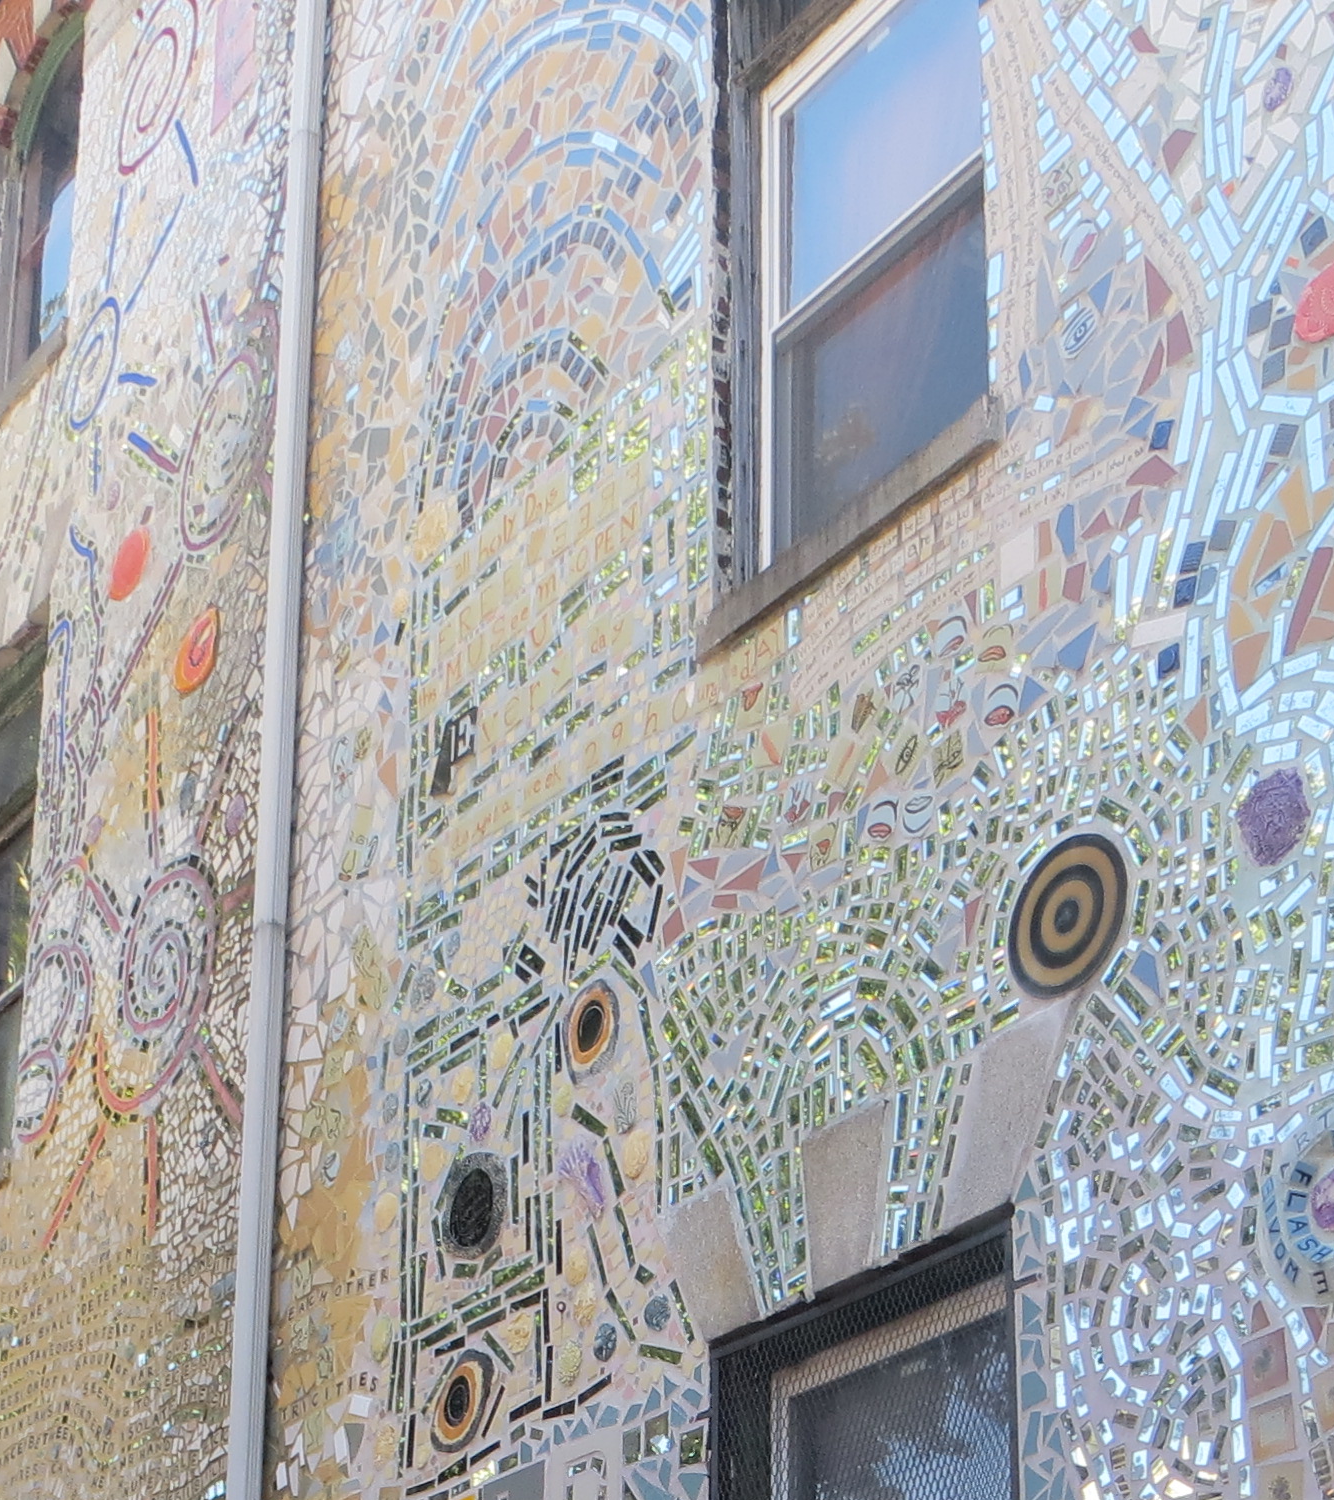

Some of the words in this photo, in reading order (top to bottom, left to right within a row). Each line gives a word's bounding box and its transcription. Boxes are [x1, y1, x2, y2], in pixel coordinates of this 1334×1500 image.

[286, 1289, 328, 1322] EACH
[334, 1268, 391, 1298] OTHER
[278, 1370, 379, 1422] TRICITIES
